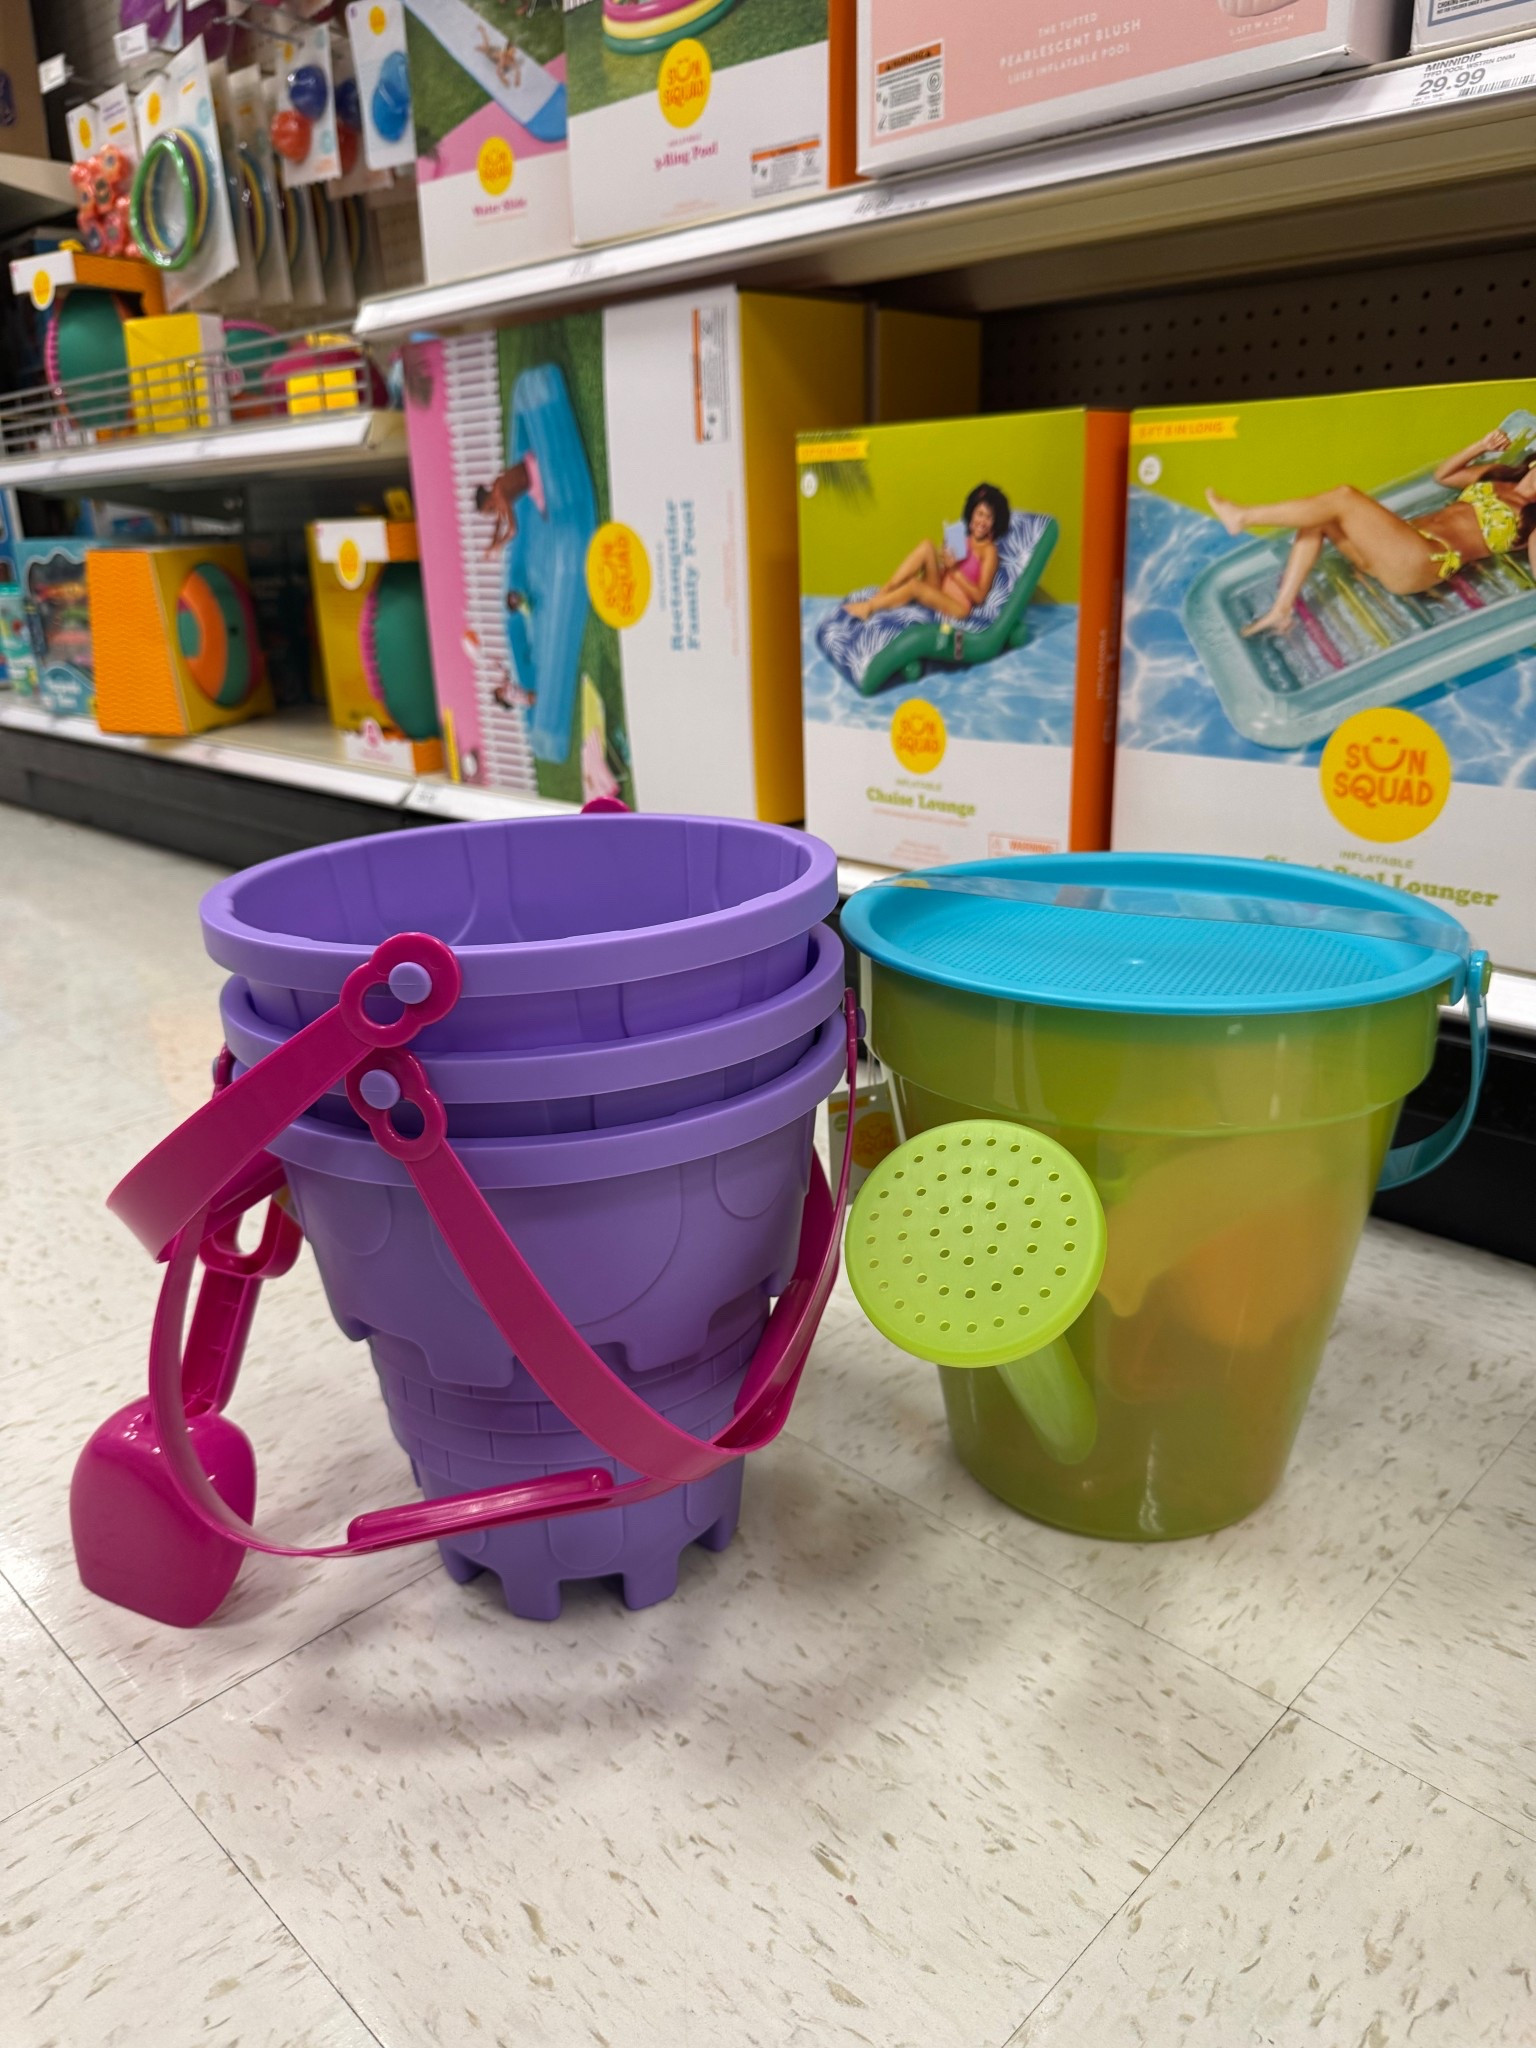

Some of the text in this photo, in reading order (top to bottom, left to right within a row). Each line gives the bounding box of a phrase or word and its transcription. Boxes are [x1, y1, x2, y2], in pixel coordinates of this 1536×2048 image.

[1000, 19, 1141, 68] PEARLESCENT BLUSH
[1036, 51, 1097, 77] INFLATABLE
[1101, 43, 1130, 60] POOL
[1425, 53, 1482, 72] MINNIDIP
[1443, 65, 1465, 74] POOL
[1416, 68, 1486, 97] 29.99
[680, 500, 697, 557] Pool
[1345, 742, 1427, 776] SUN
[866, 786, 914, 808] Chaise
[918, 794, 976, 819] Lounge
[1333, 771, 1434, 809] SQUAD
[1339, 850, 1414, 870] INFLATABLE
